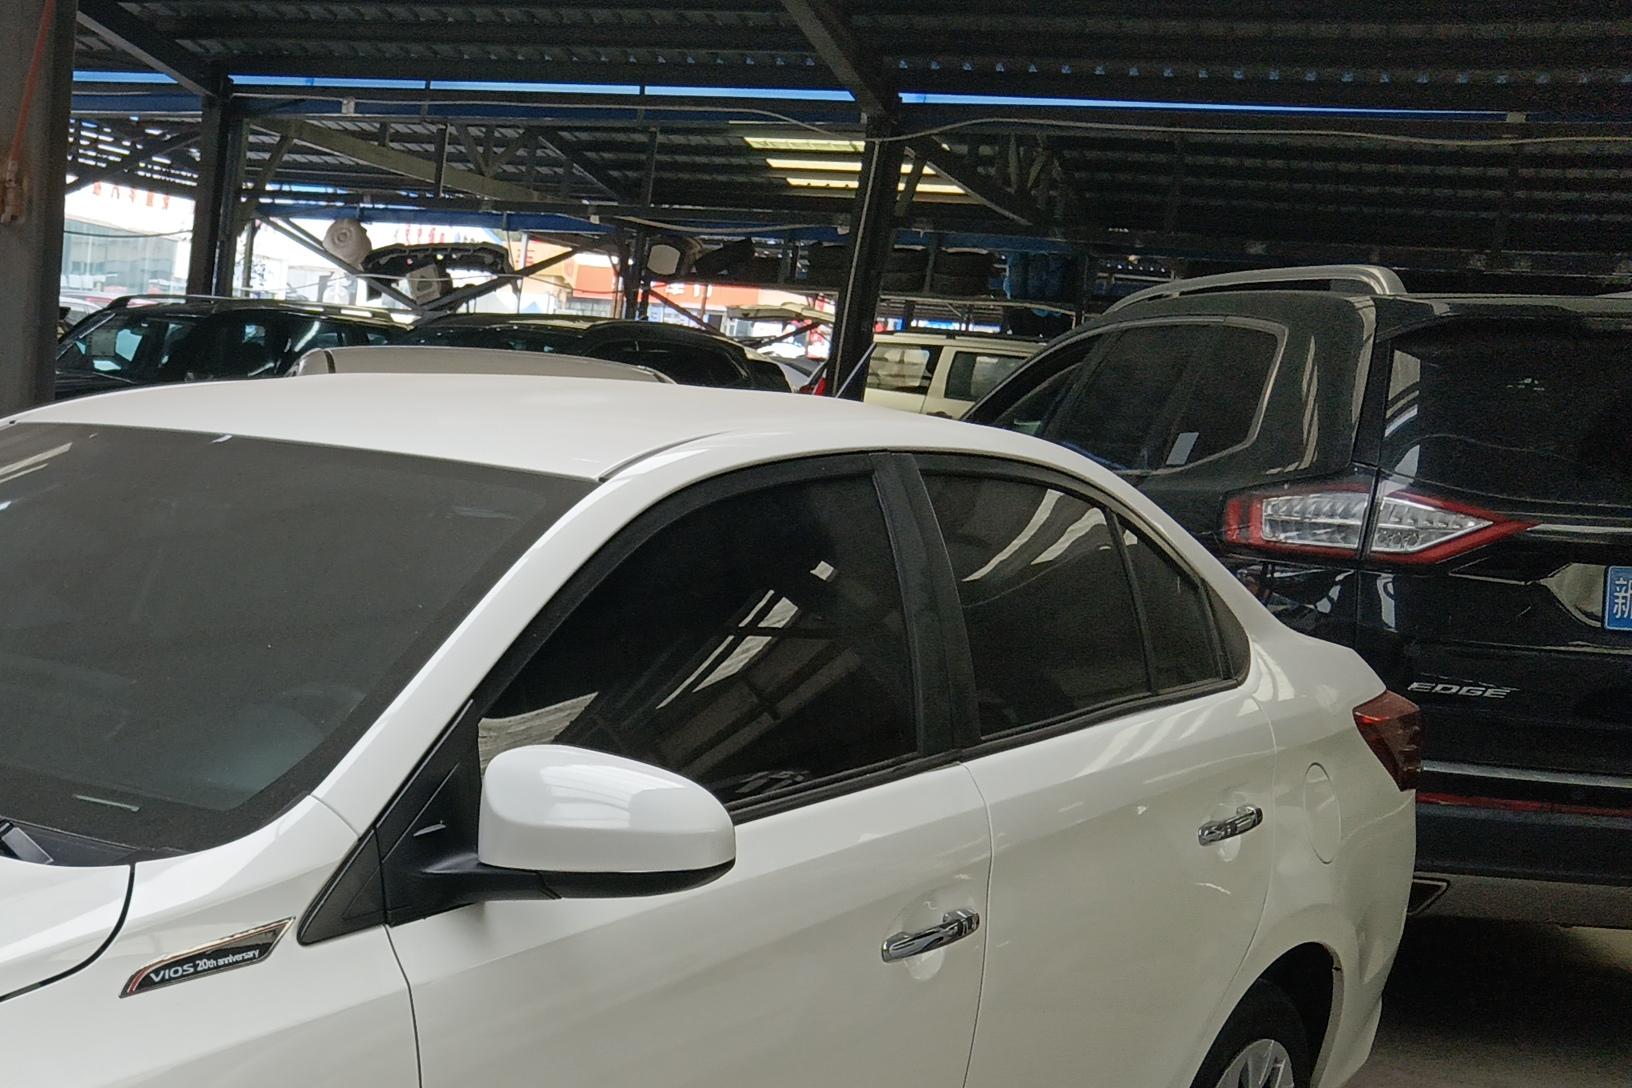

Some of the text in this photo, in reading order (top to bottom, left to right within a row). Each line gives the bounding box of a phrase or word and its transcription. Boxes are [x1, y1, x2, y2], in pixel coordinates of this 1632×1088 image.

[1407, 681, 1511, 699] EDGE
[149, 949, 260, 983] VIOS 20th anniversary
